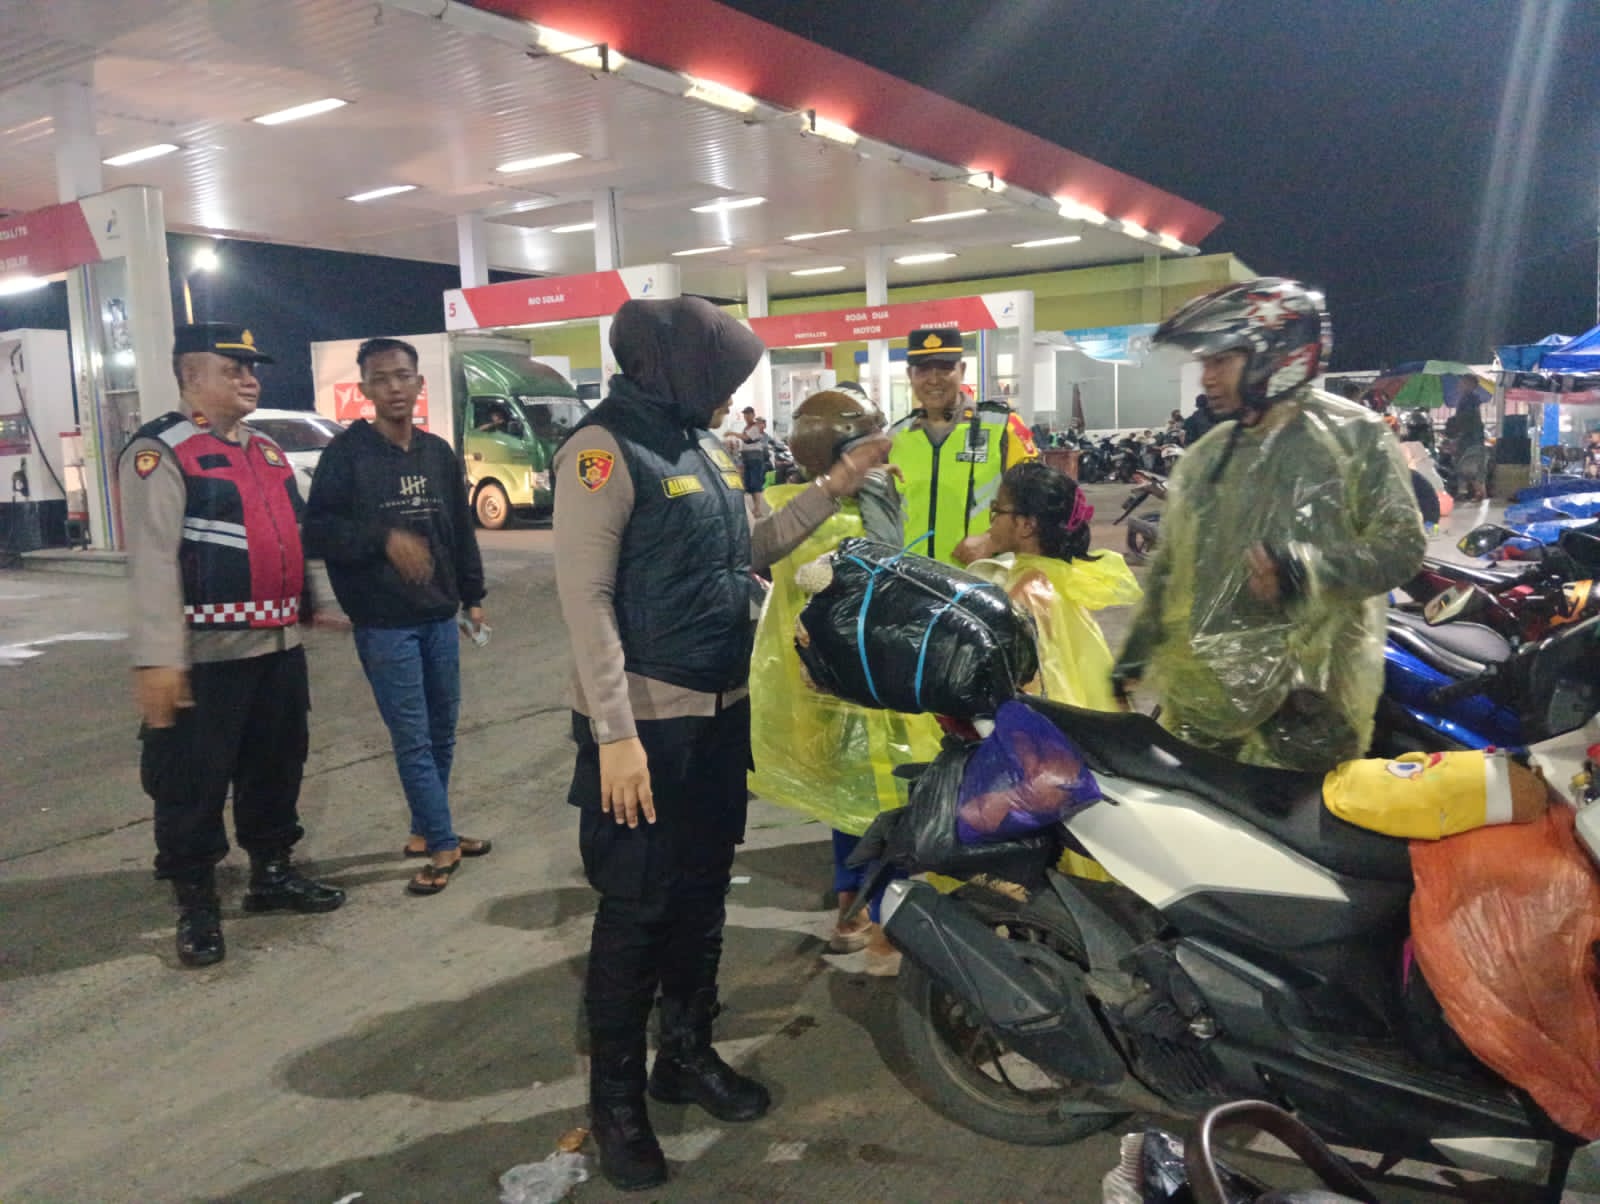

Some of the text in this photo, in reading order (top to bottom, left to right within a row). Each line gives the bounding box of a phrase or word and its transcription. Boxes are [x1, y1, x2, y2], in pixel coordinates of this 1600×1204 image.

[542, 294, 565, 305] SOLAR
[448, 302, 457, 318] 5
[853, 325, 881, 335] MOTOR
